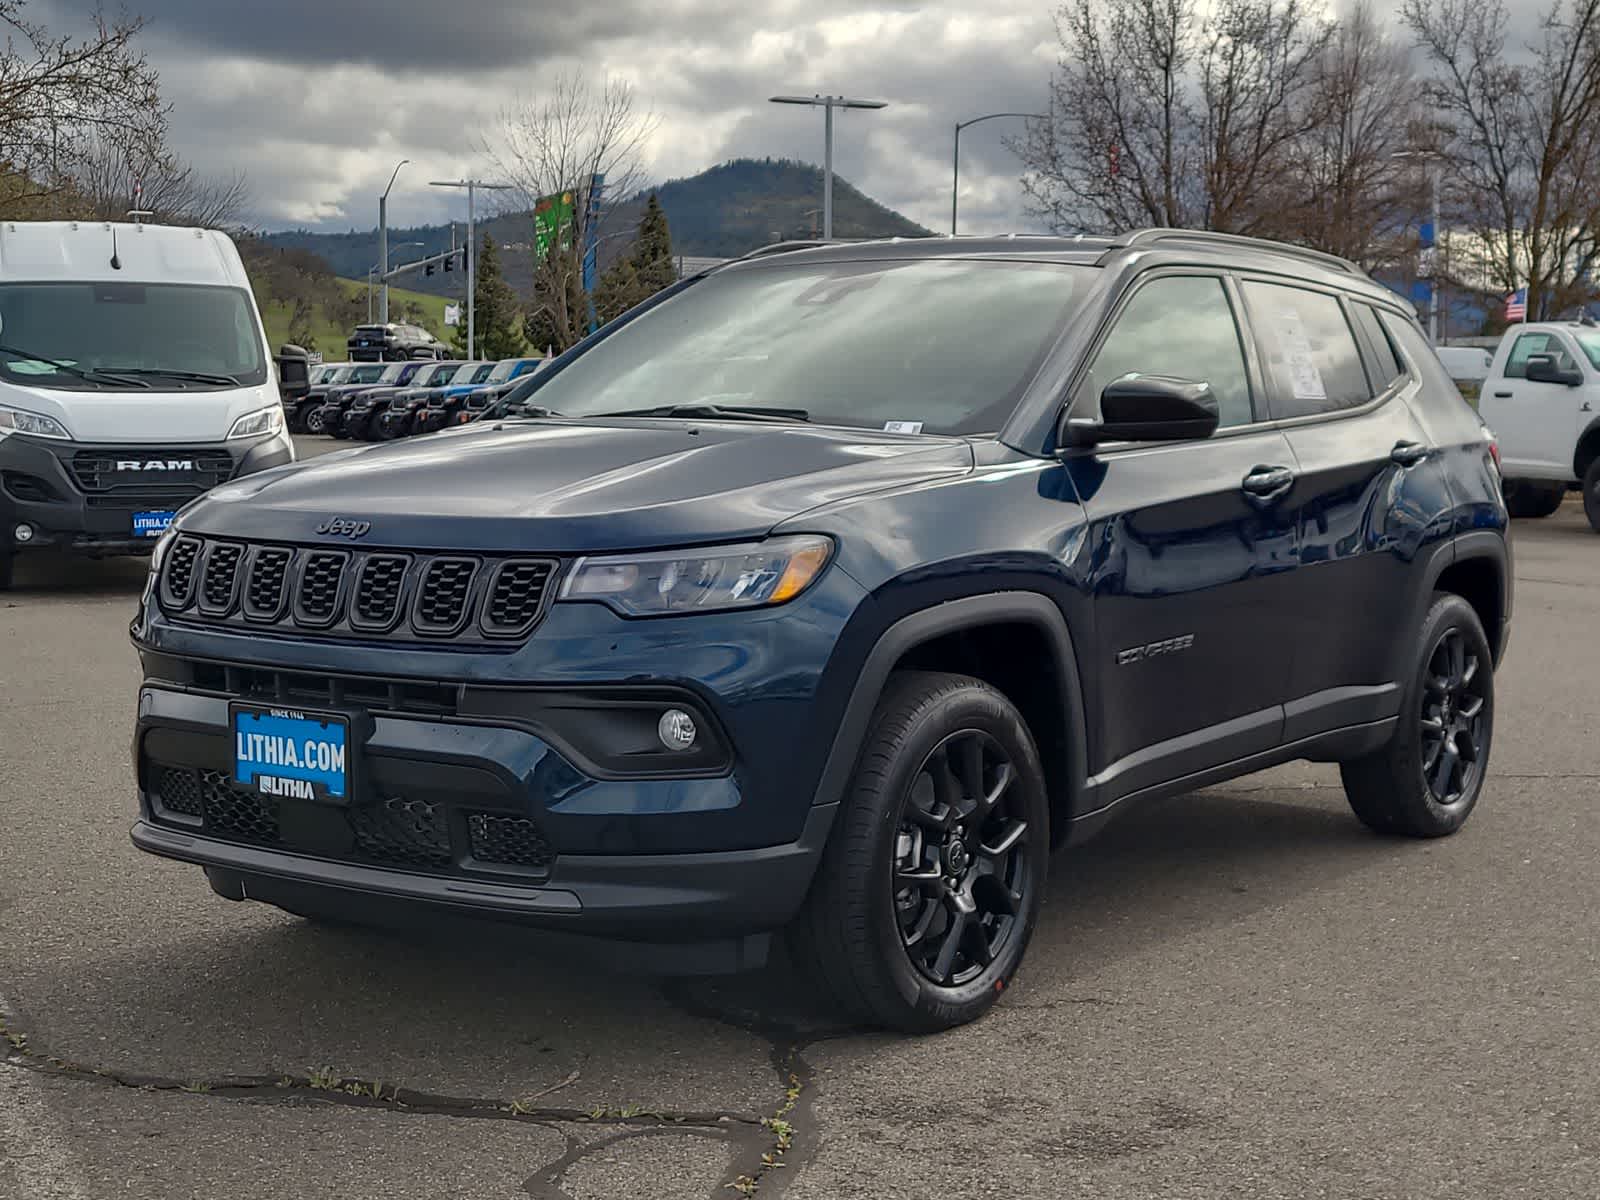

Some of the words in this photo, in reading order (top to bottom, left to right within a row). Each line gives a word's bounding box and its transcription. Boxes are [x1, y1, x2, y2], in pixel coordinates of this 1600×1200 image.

[116, 460, 192, 471] RAM
[315, 516, 370, 540] Jeep
[236, 732, 345, 774] LITHIA.COM
[271, 777, 315, 800] LITHIA
